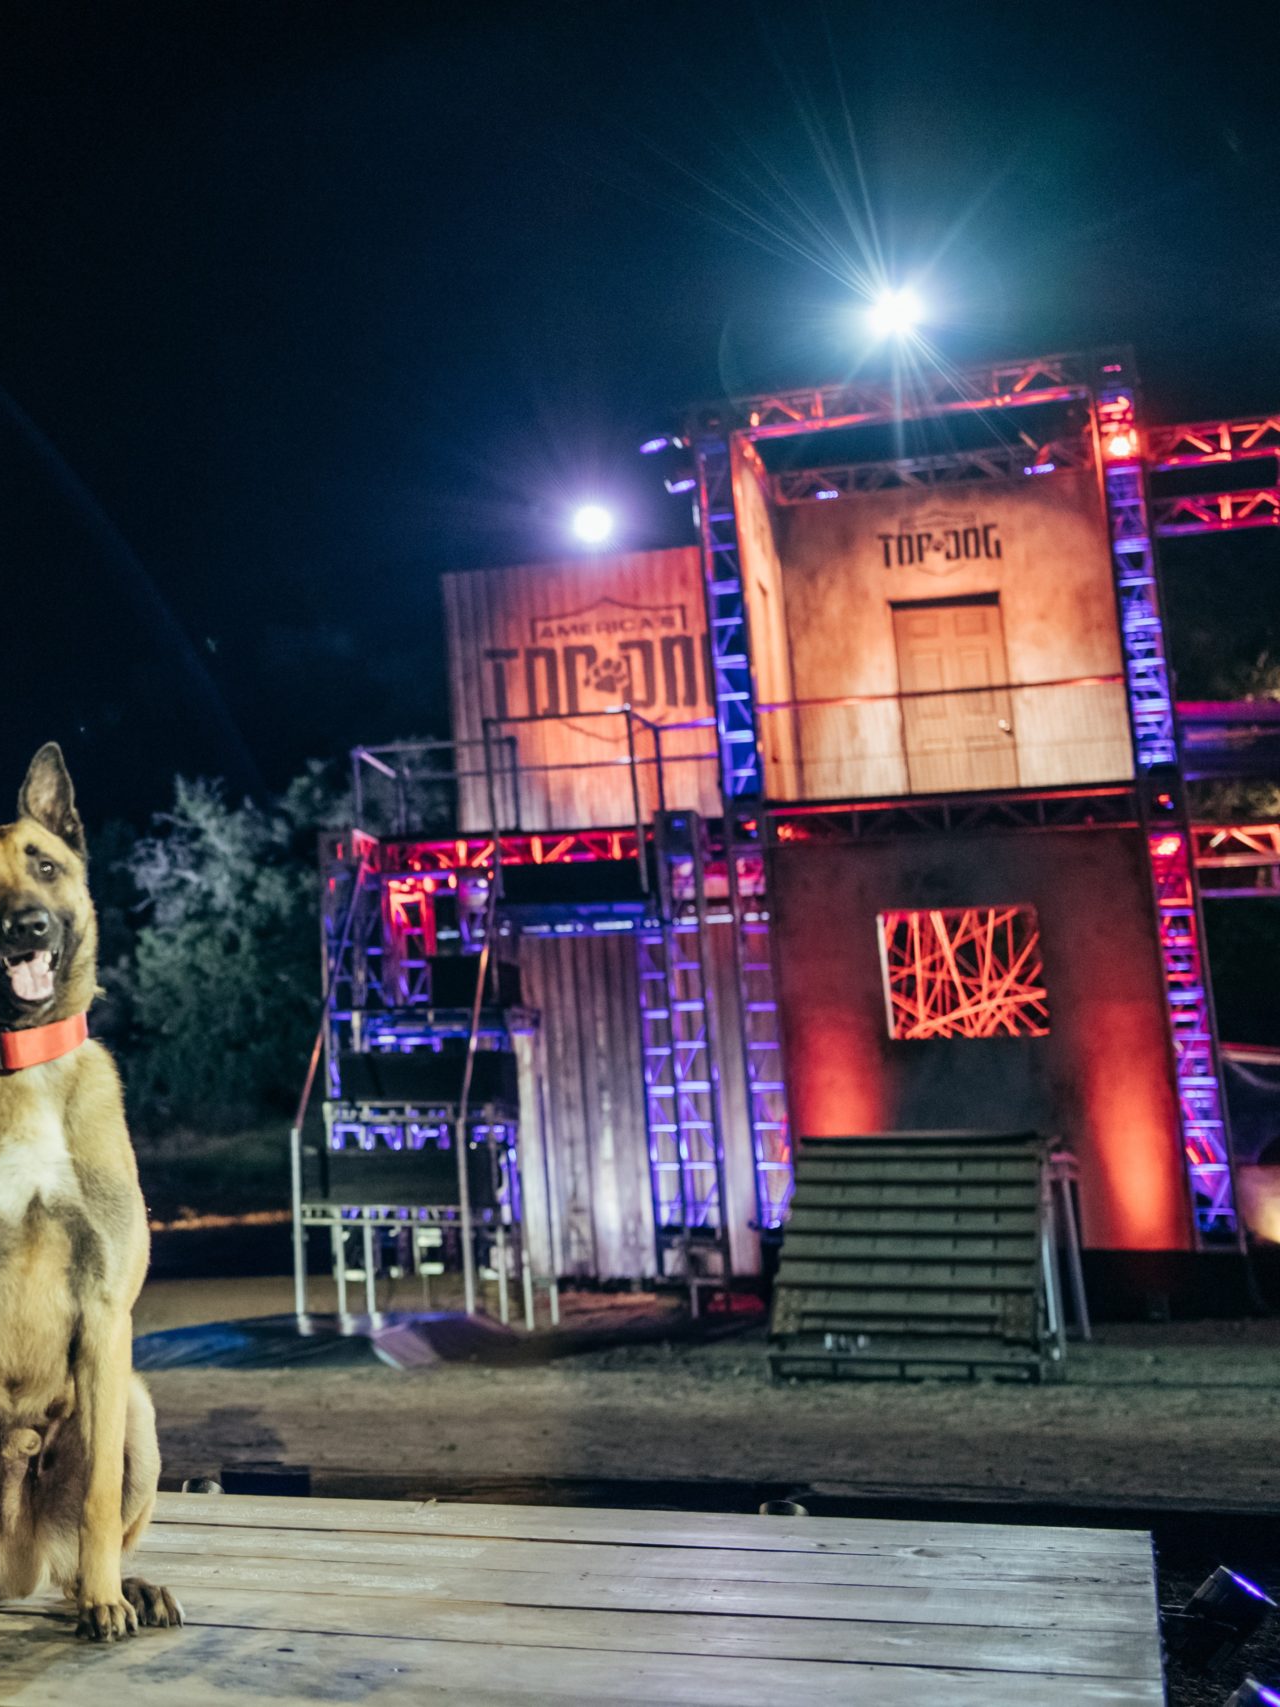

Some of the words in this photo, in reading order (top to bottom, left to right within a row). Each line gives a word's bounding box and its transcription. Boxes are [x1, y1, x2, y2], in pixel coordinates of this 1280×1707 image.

[877, 532, 933, 569] TOP
[943, 523, 1003, 560] DOG
[484, 645, 598, 718] TOP
